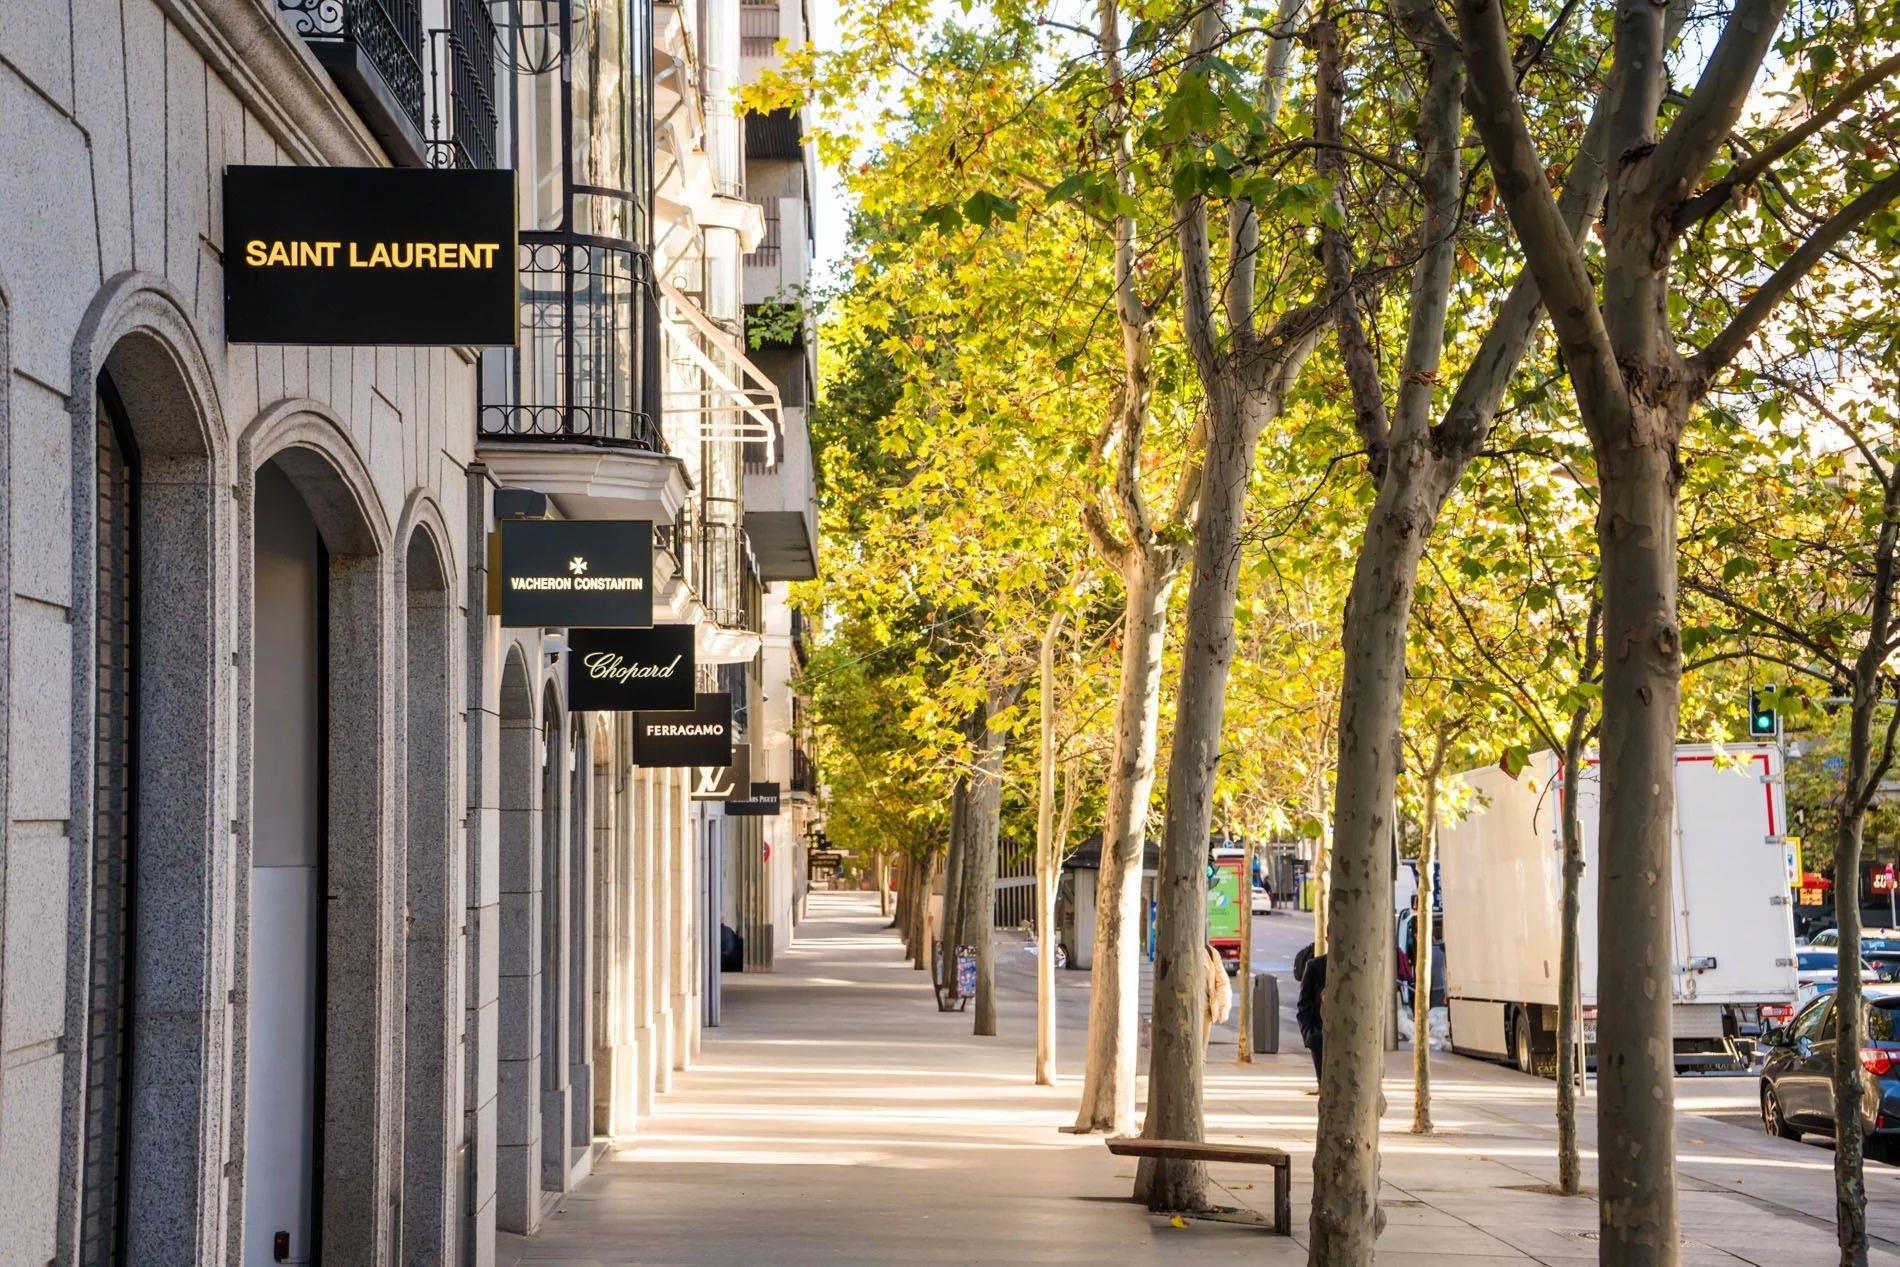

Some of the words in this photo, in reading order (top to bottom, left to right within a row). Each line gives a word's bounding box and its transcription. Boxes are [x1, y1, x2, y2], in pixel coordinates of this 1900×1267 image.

[245, 240, 341, 268] SAINT
[349, 241, 500, 269] LAURENT
[510, 576, 572, 591] VACHERON
[573, 576, 643, 591] CONSTANTIN
[583, 652, 682, 684] Chopard
[646, 725, 723, 736] FERRAGAMO
